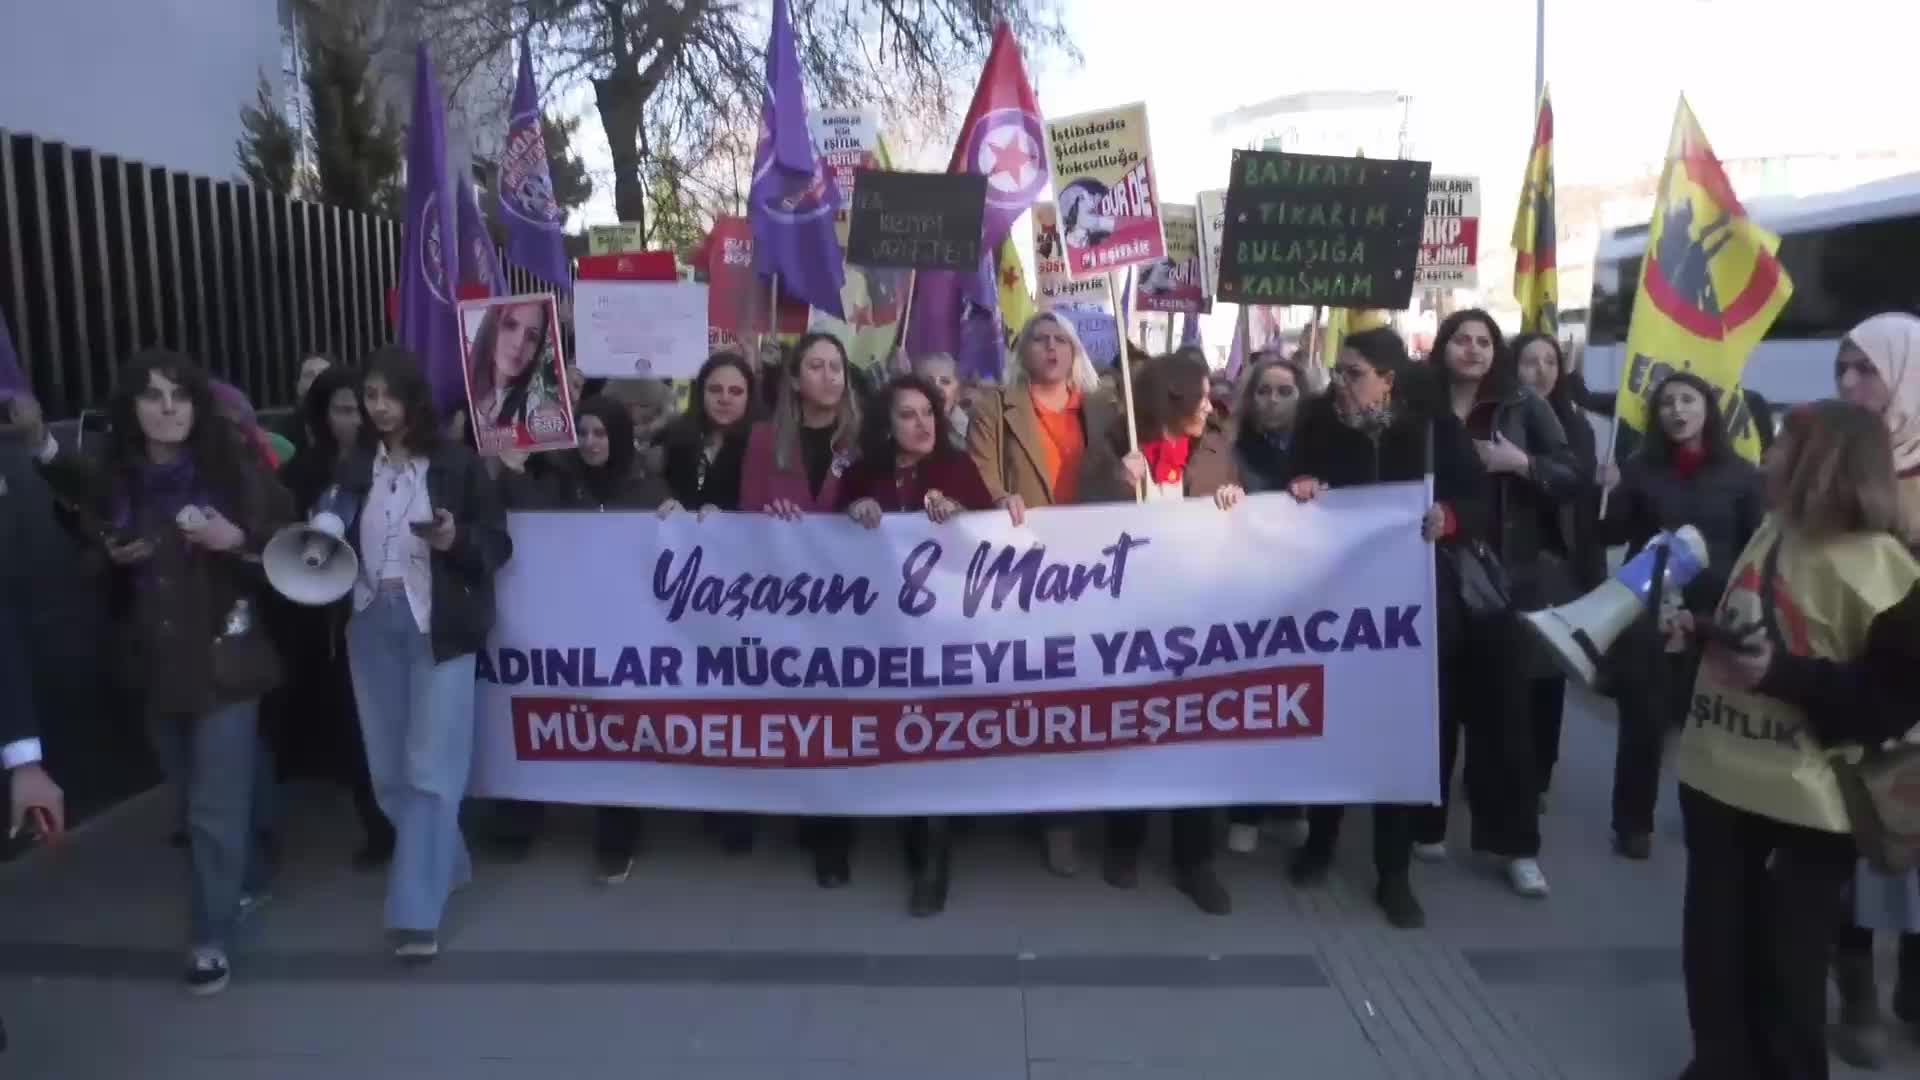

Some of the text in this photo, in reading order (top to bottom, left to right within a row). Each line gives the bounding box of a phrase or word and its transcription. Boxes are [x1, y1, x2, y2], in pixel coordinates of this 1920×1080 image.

[1428, 180, 1473, 193] INLARIN
[1423, 217, 1462, 246] AKP
[652, 531, 1151, 622] Yaşasın 8 Mart
[475, 604, 1423, 688] ADINLAR MÜCADELEYLE YAŞAYACAK
[528, 682, 1312, 760] MÜCADELEYLE ÖZGÜRLEŞECEK
[1694, 693, 1800, 750] ŞİTLİK
